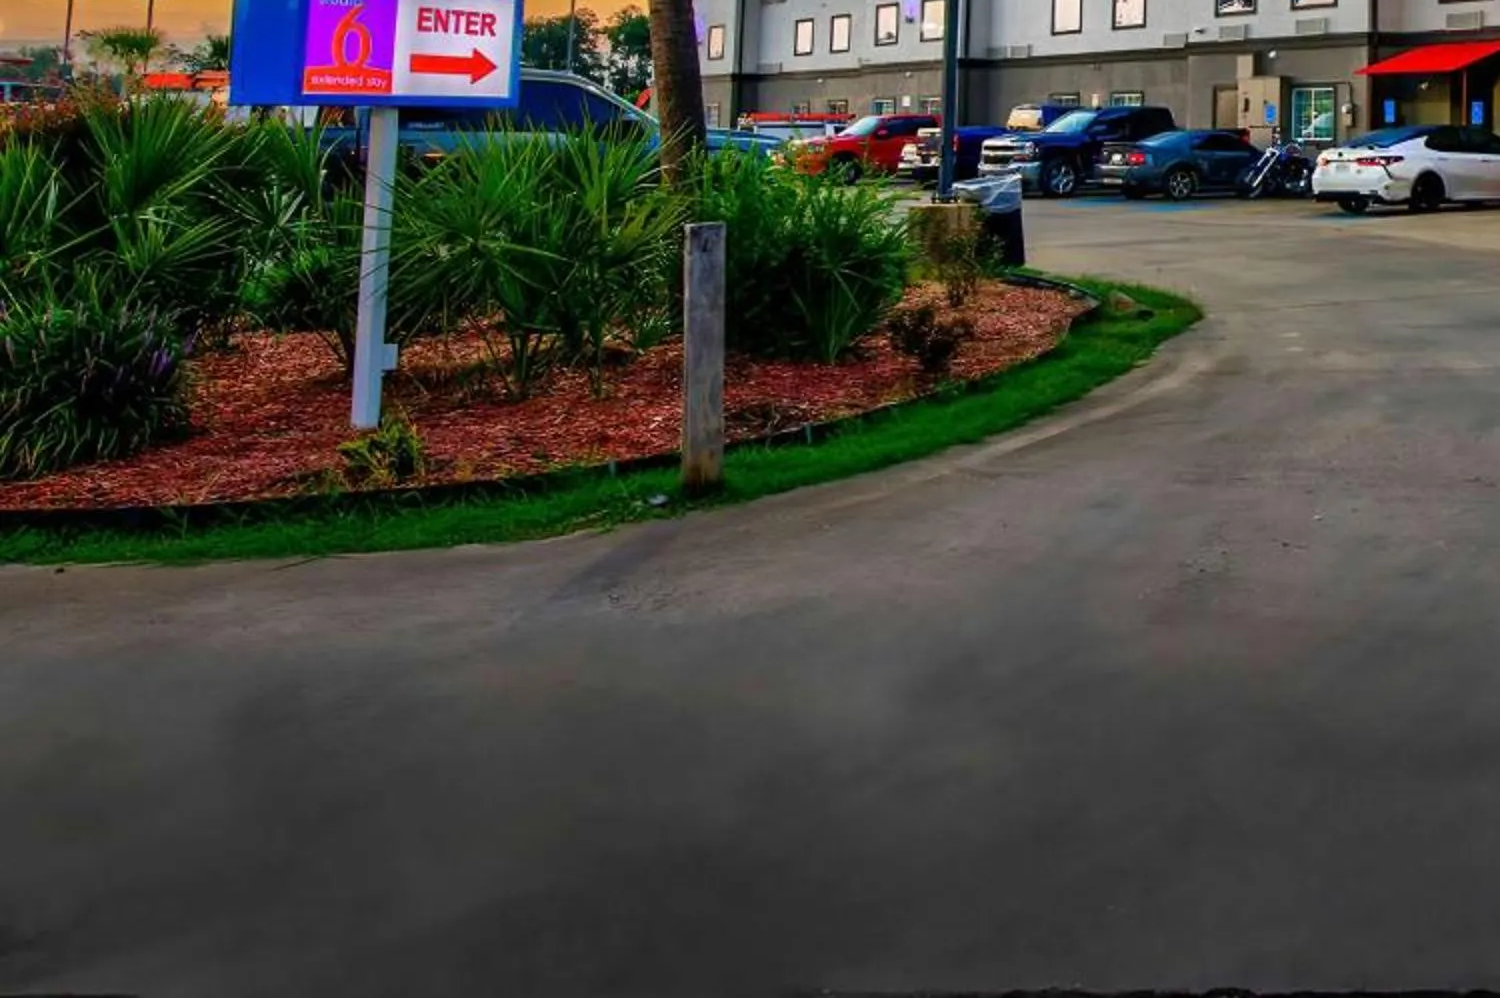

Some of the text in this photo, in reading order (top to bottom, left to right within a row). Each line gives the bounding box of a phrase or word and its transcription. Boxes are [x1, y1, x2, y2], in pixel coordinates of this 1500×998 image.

[331, 3, 372, 68] 6
[417, 7, 497, 37] ENTER
[311, 75, 363, 86] extended
